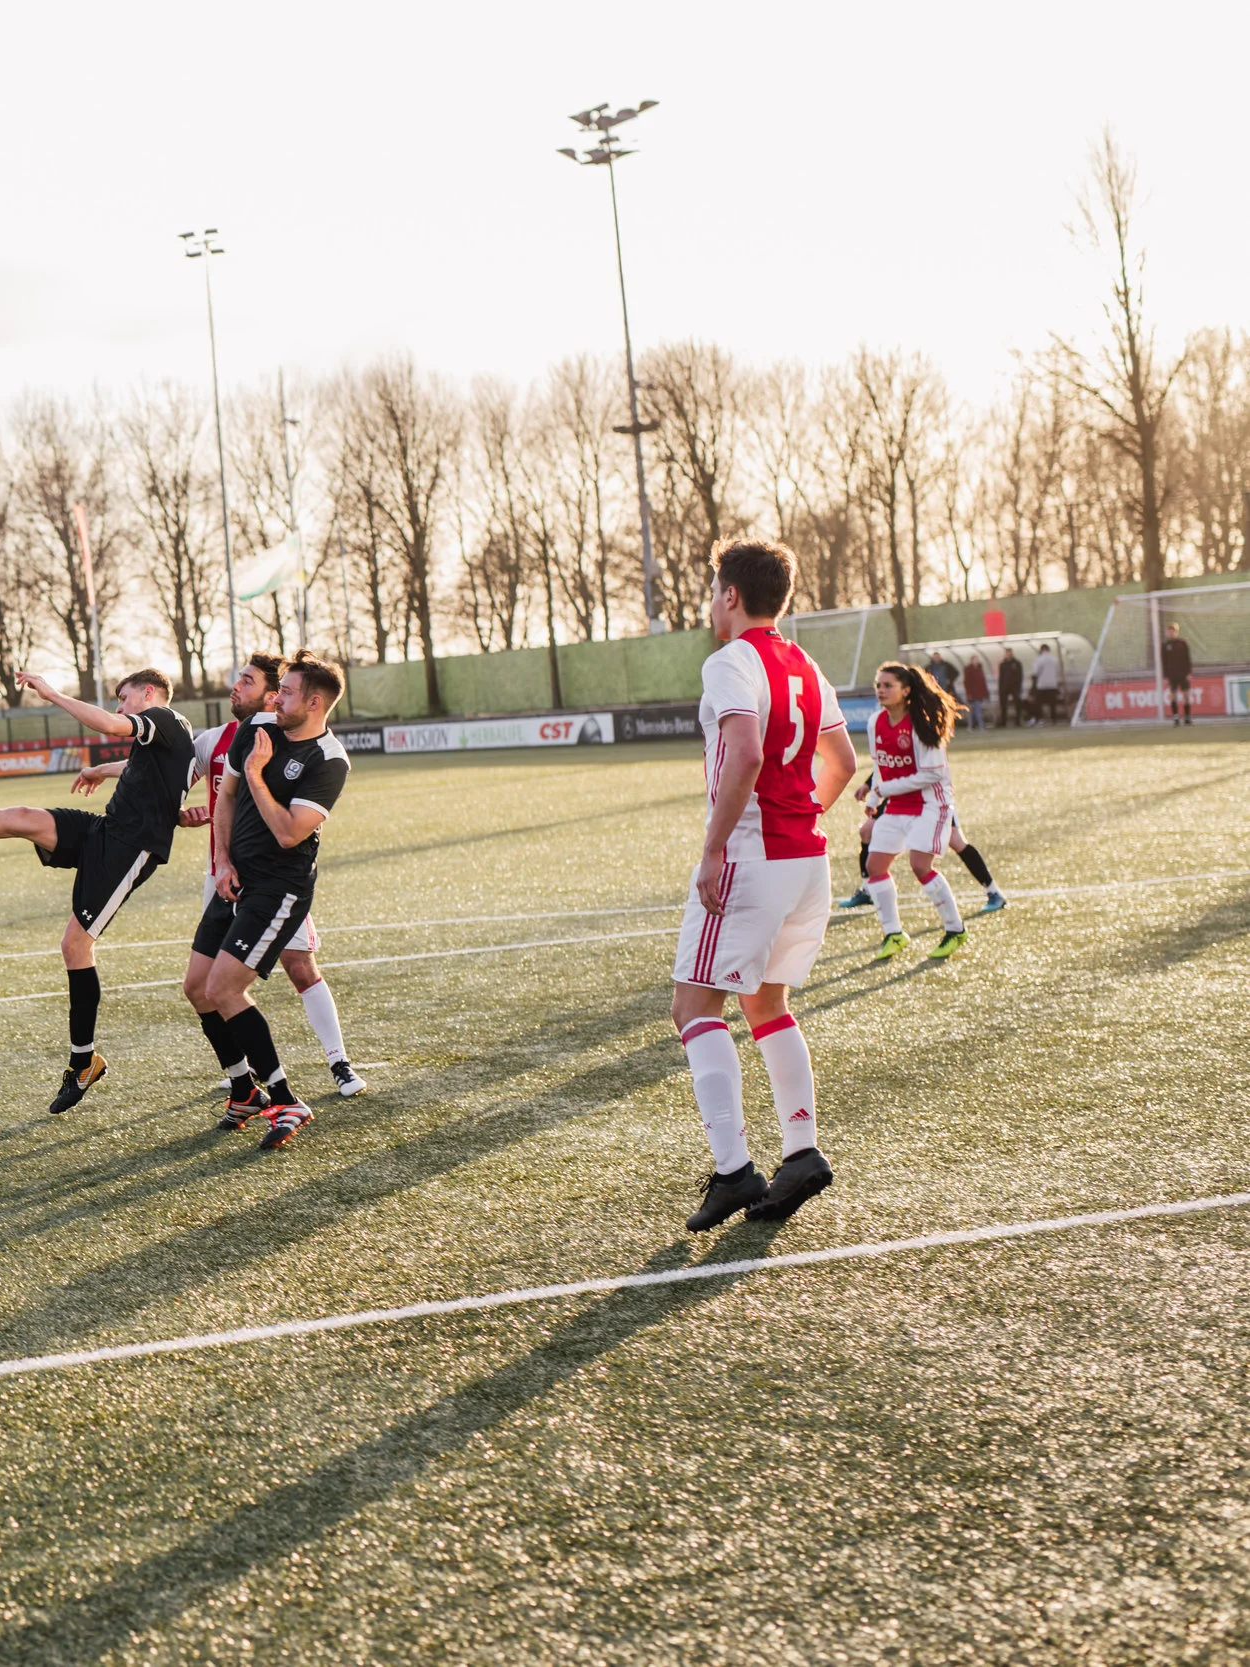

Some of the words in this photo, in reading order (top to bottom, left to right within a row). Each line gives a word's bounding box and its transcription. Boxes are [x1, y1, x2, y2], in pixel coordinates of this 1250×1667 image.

[540, 721, 573, 740] CST
[782, 675, 804, 766] 5
[389, 727, 449, 748] HIKVISION
